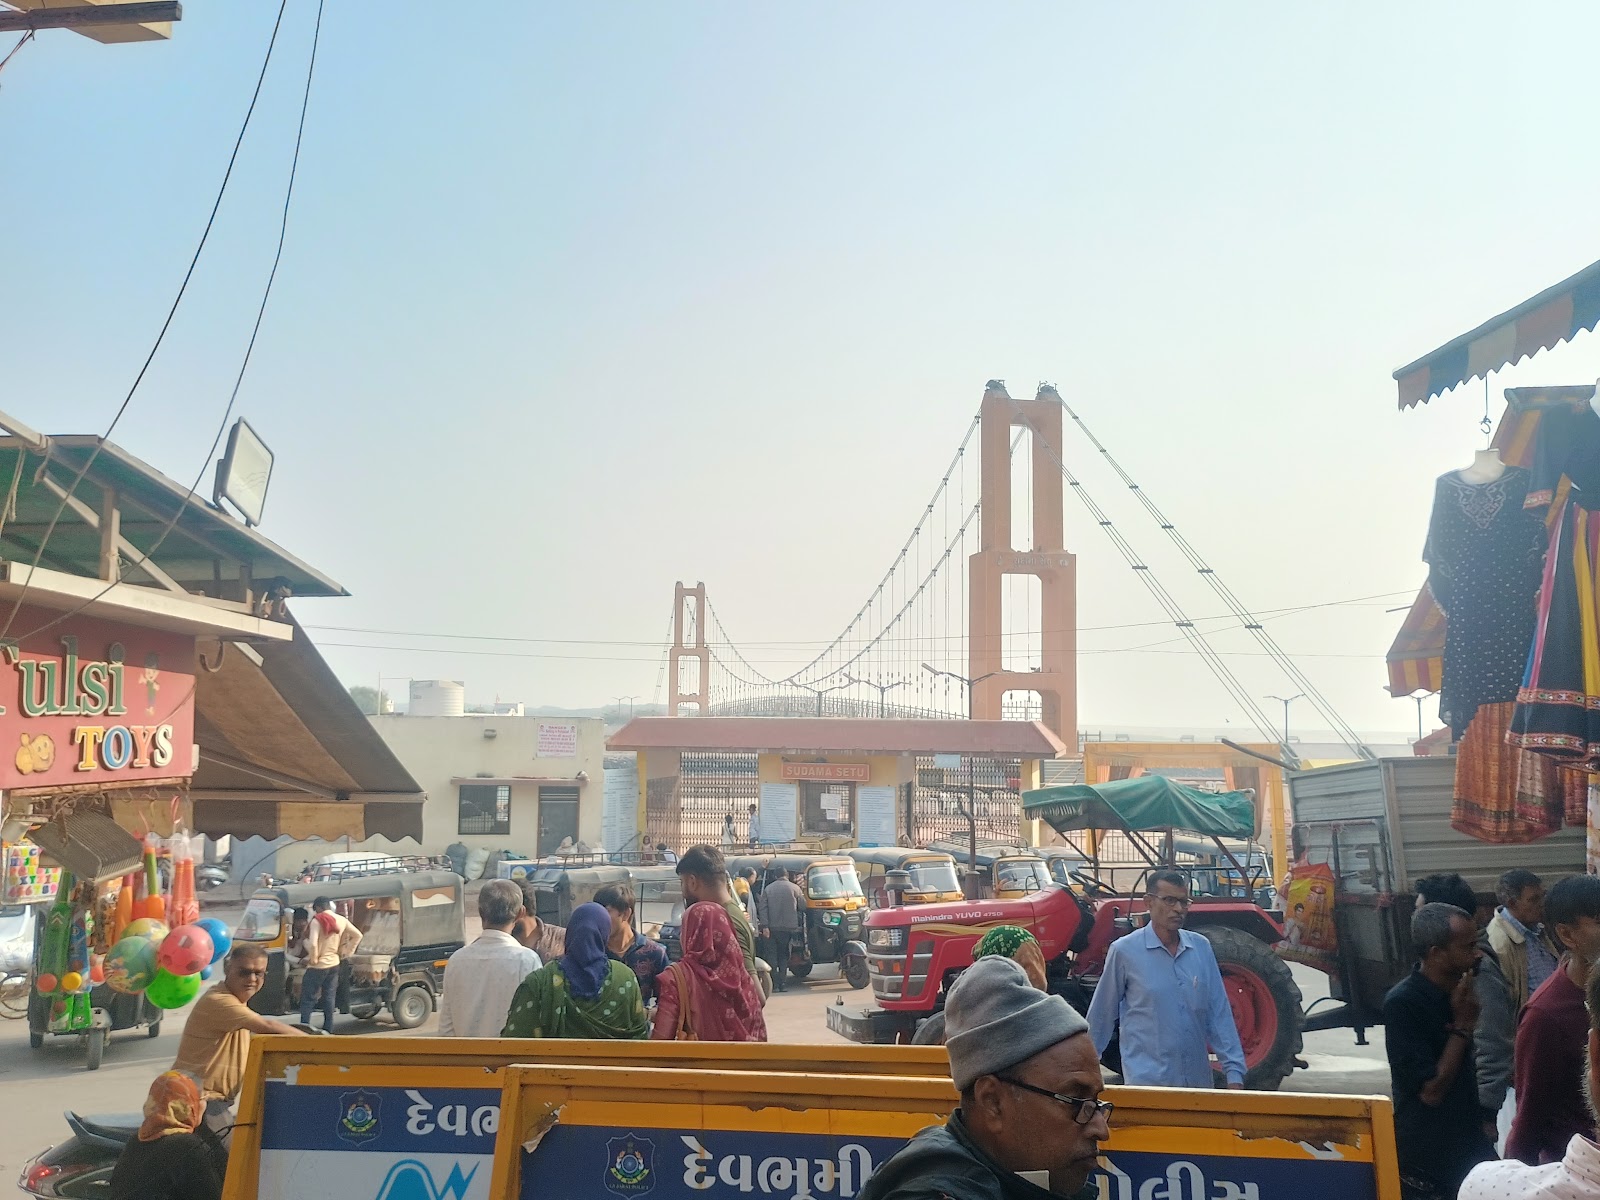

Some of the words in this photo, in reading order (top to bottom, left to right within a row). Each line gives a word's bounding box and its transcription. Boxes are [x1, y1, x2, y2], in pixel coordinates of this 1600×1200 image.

[74, 724, 173, 771] TOYS
[786, 766, 832, 776] SUDAMA
[836, 767, 865, 777] SETU
[911, 914, 953, 923] Mahindra
[955, 911, 981, 919] YUVO
